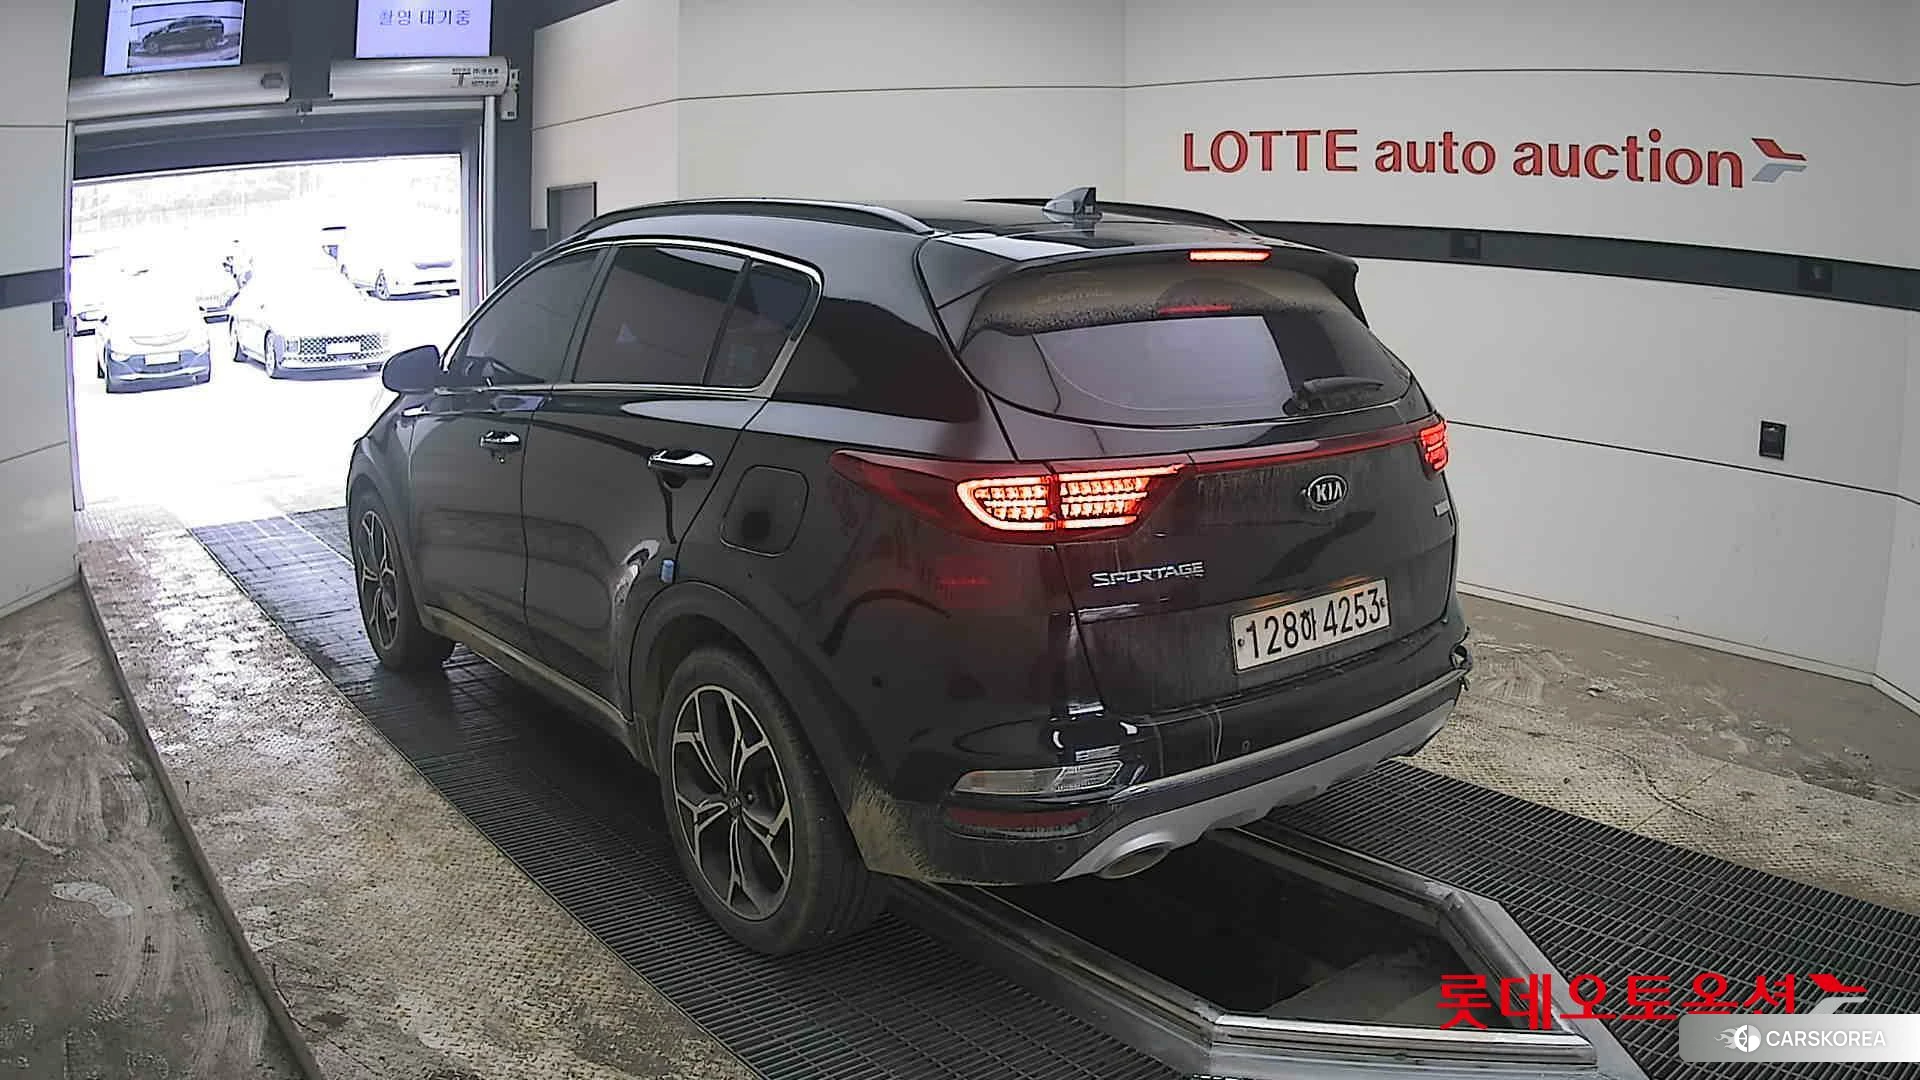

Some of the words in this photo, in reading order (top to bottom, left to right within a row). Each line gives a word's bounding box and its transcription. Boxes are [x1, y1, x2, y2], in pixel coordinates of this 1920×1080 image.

[419, 7, 472, 26] 대기중
[1182, 129, 1358, 173] LOTTE
[1375, 131, 1497, 174] auto
[1513, 128, 1744, 187] auction
[1314, 481, 1343, 502] KIA
[1091, 561, 1205, 588] SPORTAGE
[1246, 609, 1317, 659] 128하
[1323, 588, 1381, 636] 4253
